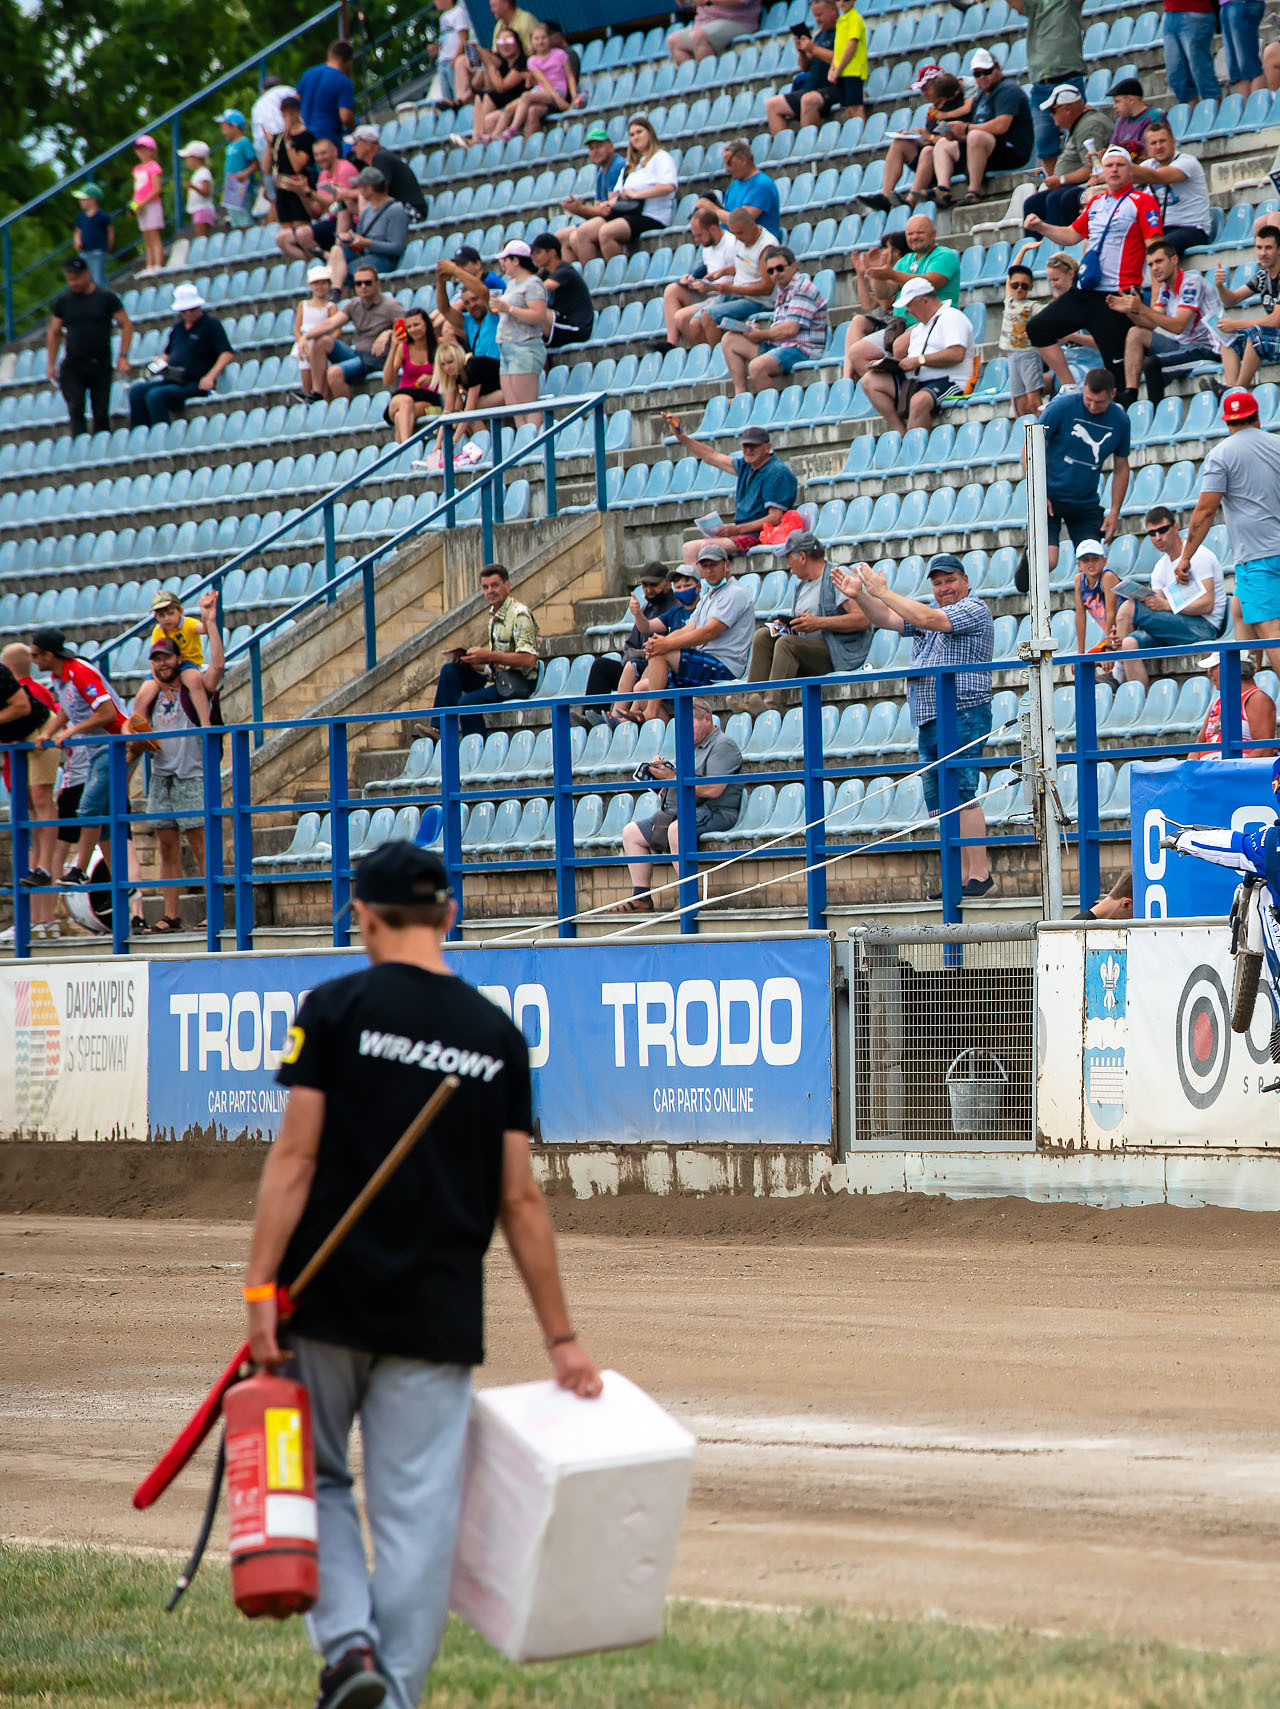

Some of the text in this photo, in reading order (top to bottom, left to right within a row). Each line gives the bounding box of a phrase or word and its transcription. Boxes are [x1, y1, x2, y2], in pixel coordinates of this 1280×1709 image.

[66, 980, 135, 1019] DAUGAVPILS
[170, 990, 313, 1072] TROD
[601, 976, 803, 1068] TRODO
[78, 1034, 129, 1073] SPEEDWAY
[208, 1089, 228, 1113] CAR
[228, 1089, 258, 1113] PARTS
[653, 1086, 754, 1113] CAR PARTS ONLINE
